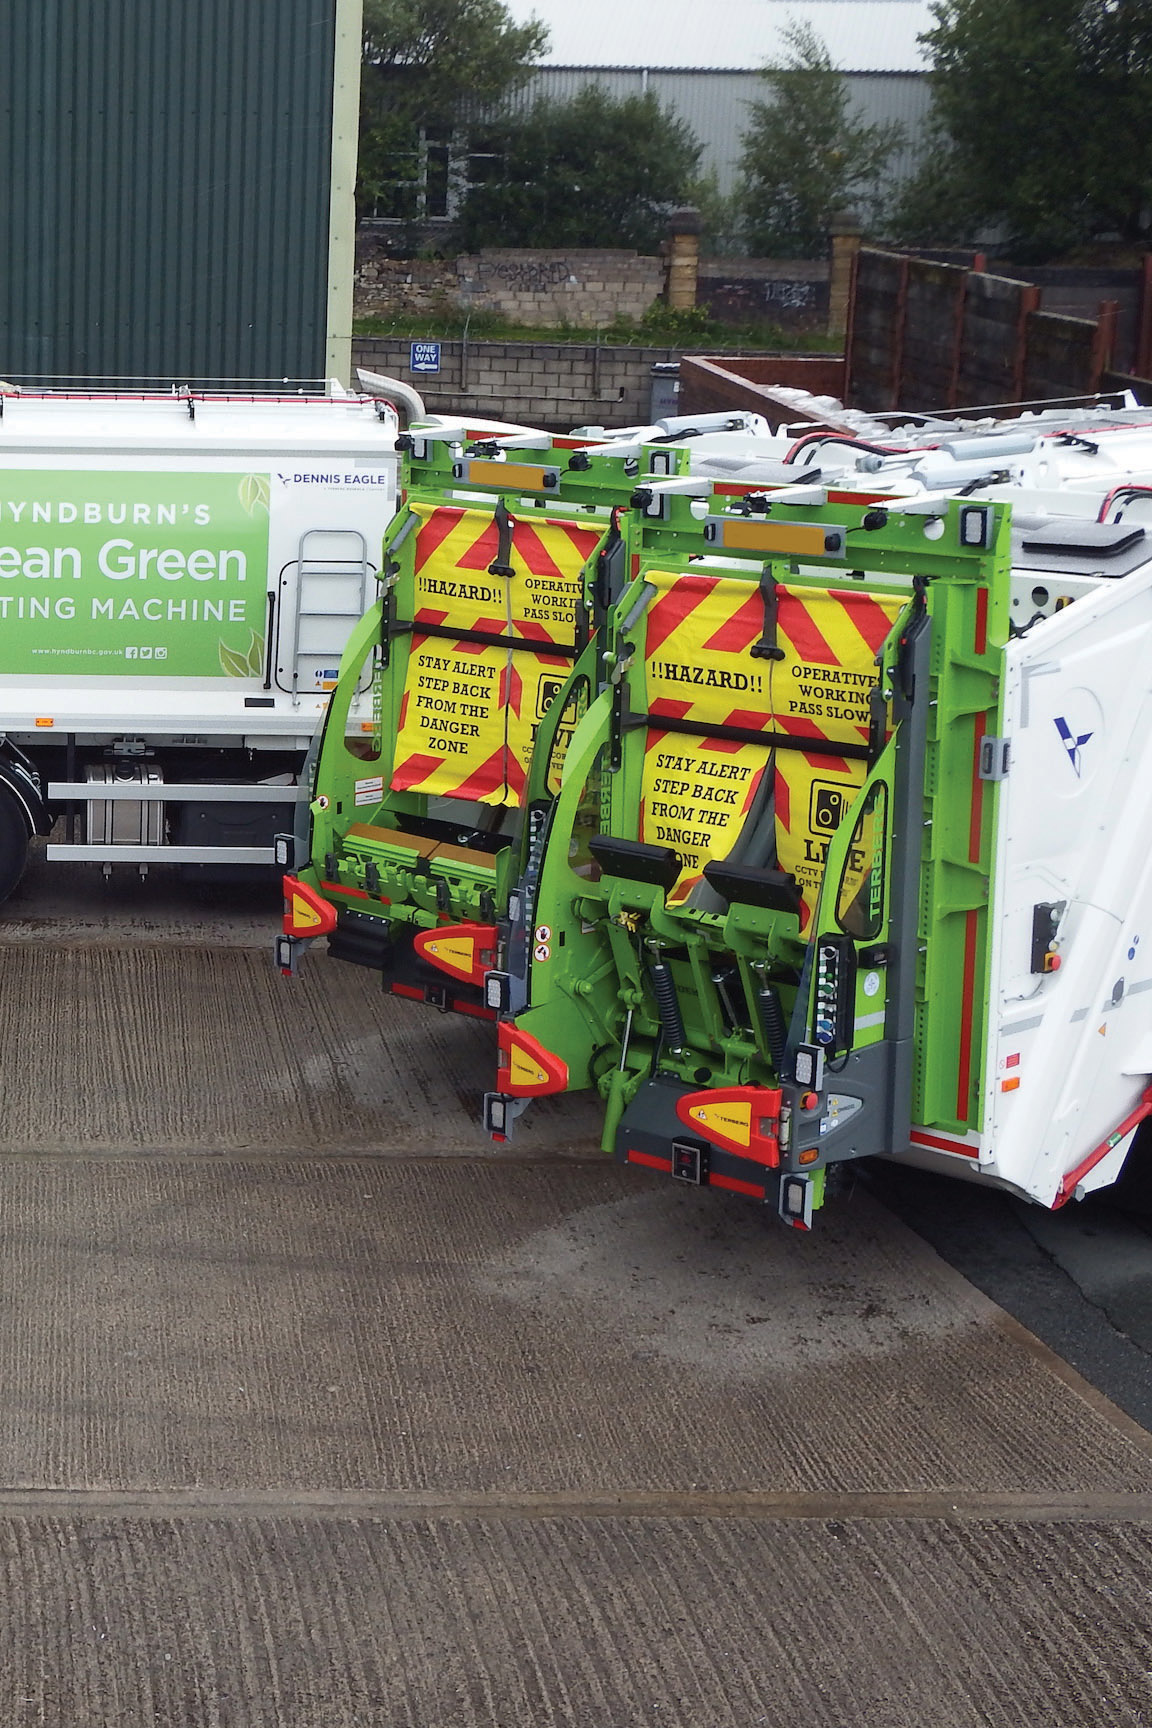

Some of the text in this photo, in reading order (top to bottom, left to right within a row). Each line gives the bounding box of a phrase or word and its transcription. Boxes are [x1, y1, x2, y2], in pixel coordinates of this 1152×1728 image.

[414, 353, 437, 362] WAY
[415, 344, 436, 353] ONE
[293, 474, 385, 485] DENNIS EAGLE
[98, 538, 247, 582] Green
[417, 577, 503, 604] !!HAZARD!!
[91, 598, 247, 622] MACHINE
[523, 607, 575, 623] PASS SLO
[31, 648, 123, 656] www.hyndburnbc.gov.uk
[418, 655, 496, 680] STAY ALERT
[650, 661, 763, 693] !!HAZARD!!
[417, 675, 492, 700] STEP BACK
[416, 696, 489, 719] FROM THE
[788, 700, 871, 722] PASS SLOW
[420, 715, 480, 738] DANGER
[428, 737, 469, 755] ZONE
[656, 754, 751, 781] STAY ALERT
[653, 778, 739, 805] STEP BACK
[651, 801, 729, 827] FROM THE
[656, 826, 711, 848] DANGER
[795, 865, 818, 876] CCTV
[720, 1116, 749, 1127] TERBERG
